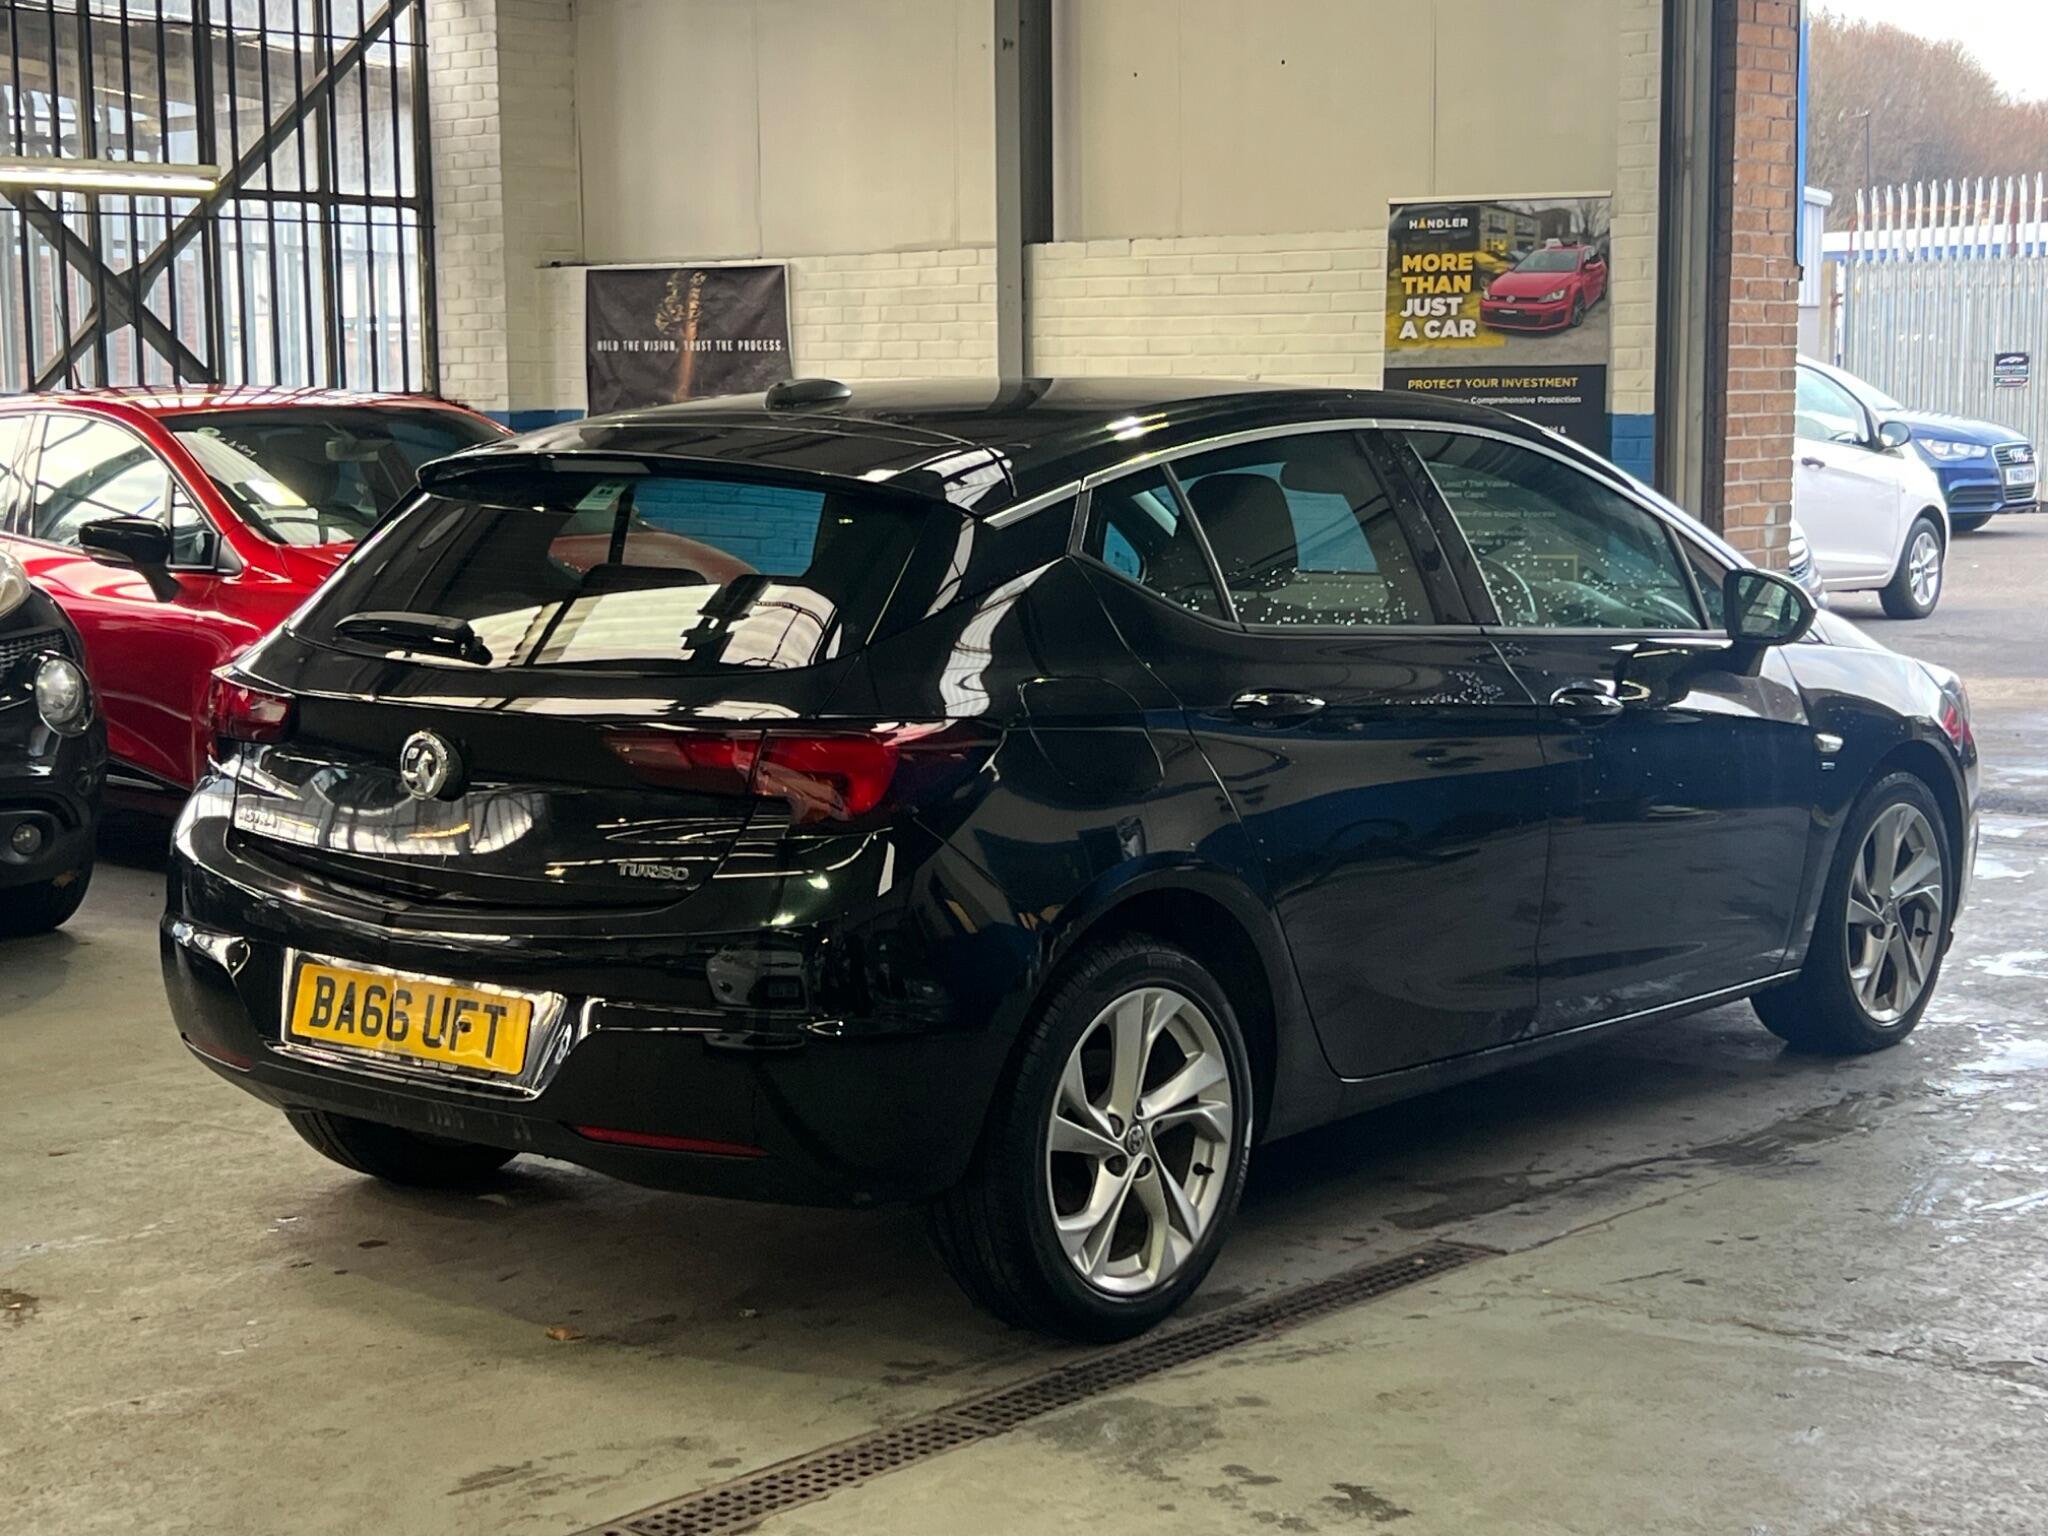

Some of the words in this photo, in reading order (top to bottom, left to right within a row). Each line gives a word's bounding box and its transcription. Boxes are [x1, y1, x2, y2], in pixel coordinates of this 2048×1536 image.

[1409, 218, 1468, 229] HANDLER
[1402, 253, 1473, 272] MORE
[1401, 274, 1471, 294] THAN
[1400, 296, 1463, 317] JUST
[1399, 320, 1418, 339] A
[1423, 318, 1476, 339] CAR
[623, 340, 640, 352] THE
[716, 340, 733, 352] THE
[1407, 378, 1461, 390] PROTECT
[1464, 378, 1499, 388] YOUR
[1501, 377, 1578, 388] INVESTMENT
[1470, 396, 1536, 405] Comprehensive
[1537, 395, 1582, 404] Protection
[618, 863, 689, 881] TURBO
[309, 975, 413, 1042] BA66
[422, 994, 507, 1059] UFT
